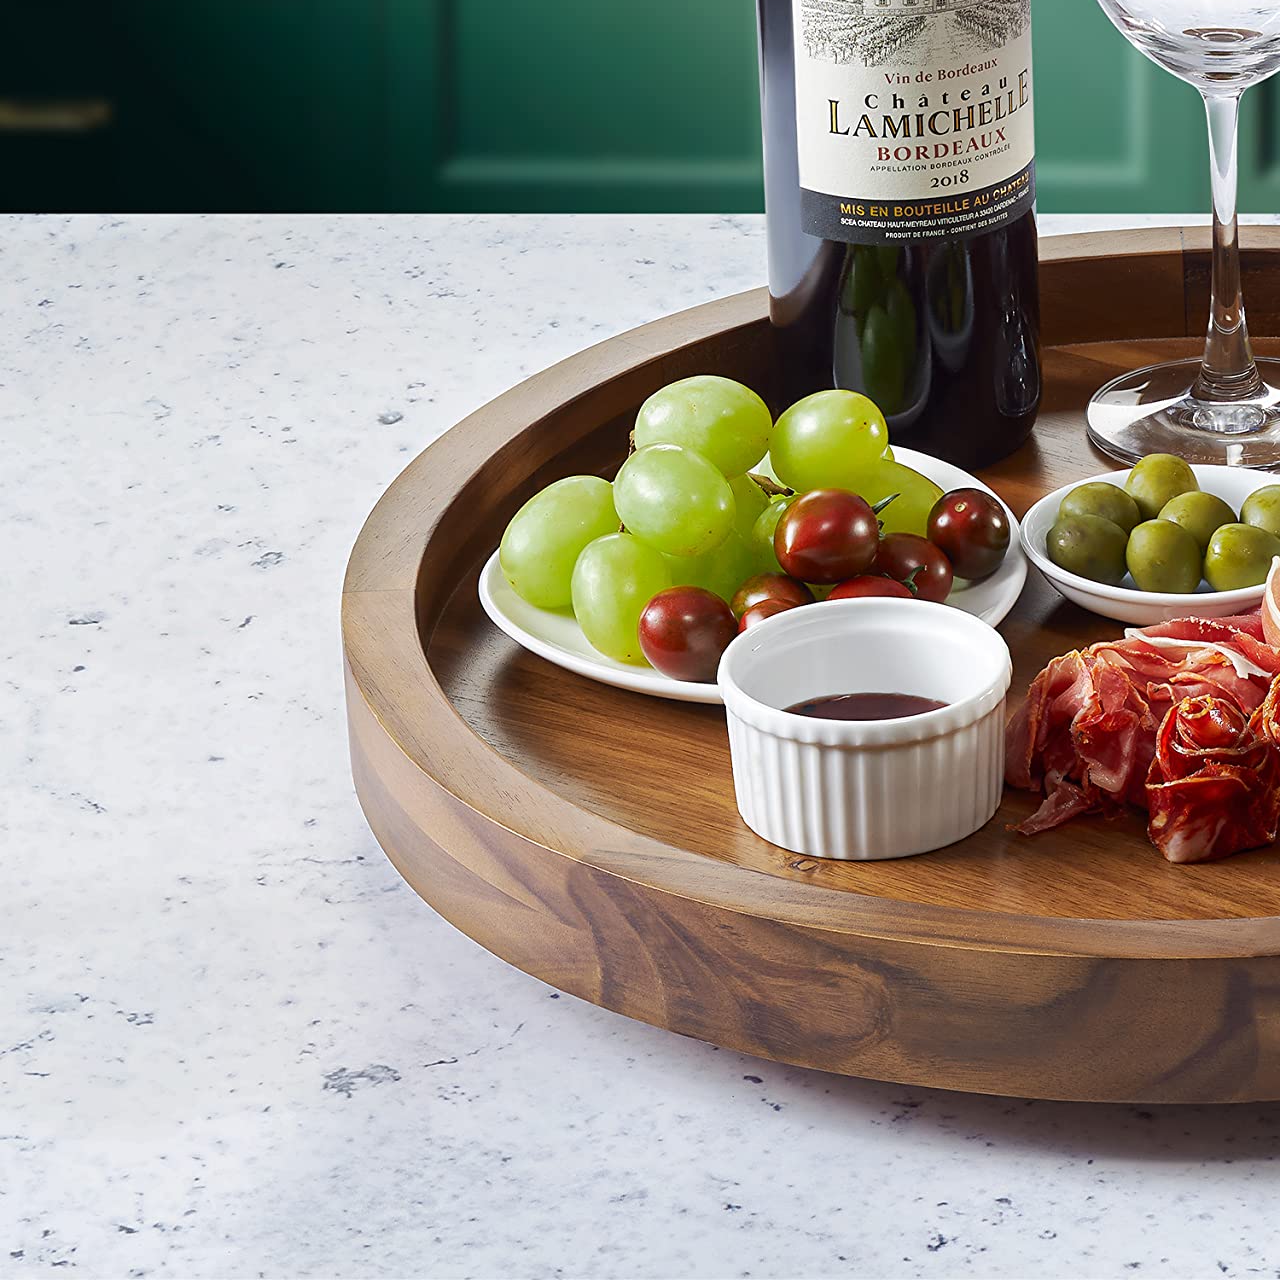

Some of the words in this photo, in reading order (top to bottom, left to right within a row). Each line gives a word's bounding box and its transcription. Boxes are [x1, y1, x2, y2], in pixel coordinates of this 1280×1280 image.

[884, 73, 910, 85] Vin
[915, 70, 933, 83] de
[937, 56, 998, 81] Bordeaux
[827, 68, 1029, 139] LAMICHELLE
[864, 75, 1007, 110] Château
[877, 126, 1007, 161] BORDEAUX
[870, 164, 927, 172] APPELLATION
[930, 157, 972, 171] BORDEAUX
[930, 169, 970, 189] 2018
[840, 202, 865, 217] MIS
[869, 206, 889, 217] EN
[894, 197, 970, 217] BOUTEILLE
[973, 192, 990, 207] AU
[840, 217, 857, 227] SCEA
[857, 218, 887, 229] CHATEAU
[887, 218, 937, 229] HAUT-MEYREAU
[937, 212, 974, 226] VITICULTEUR
[885, 231, 912, 239] PRODUIT
[912, 230, 922, 238] DE
[922, 229, 945, 238] FRANCE
[950, 222, 977, 234] CONTIENT
[977, 219, 988, 228] DES
